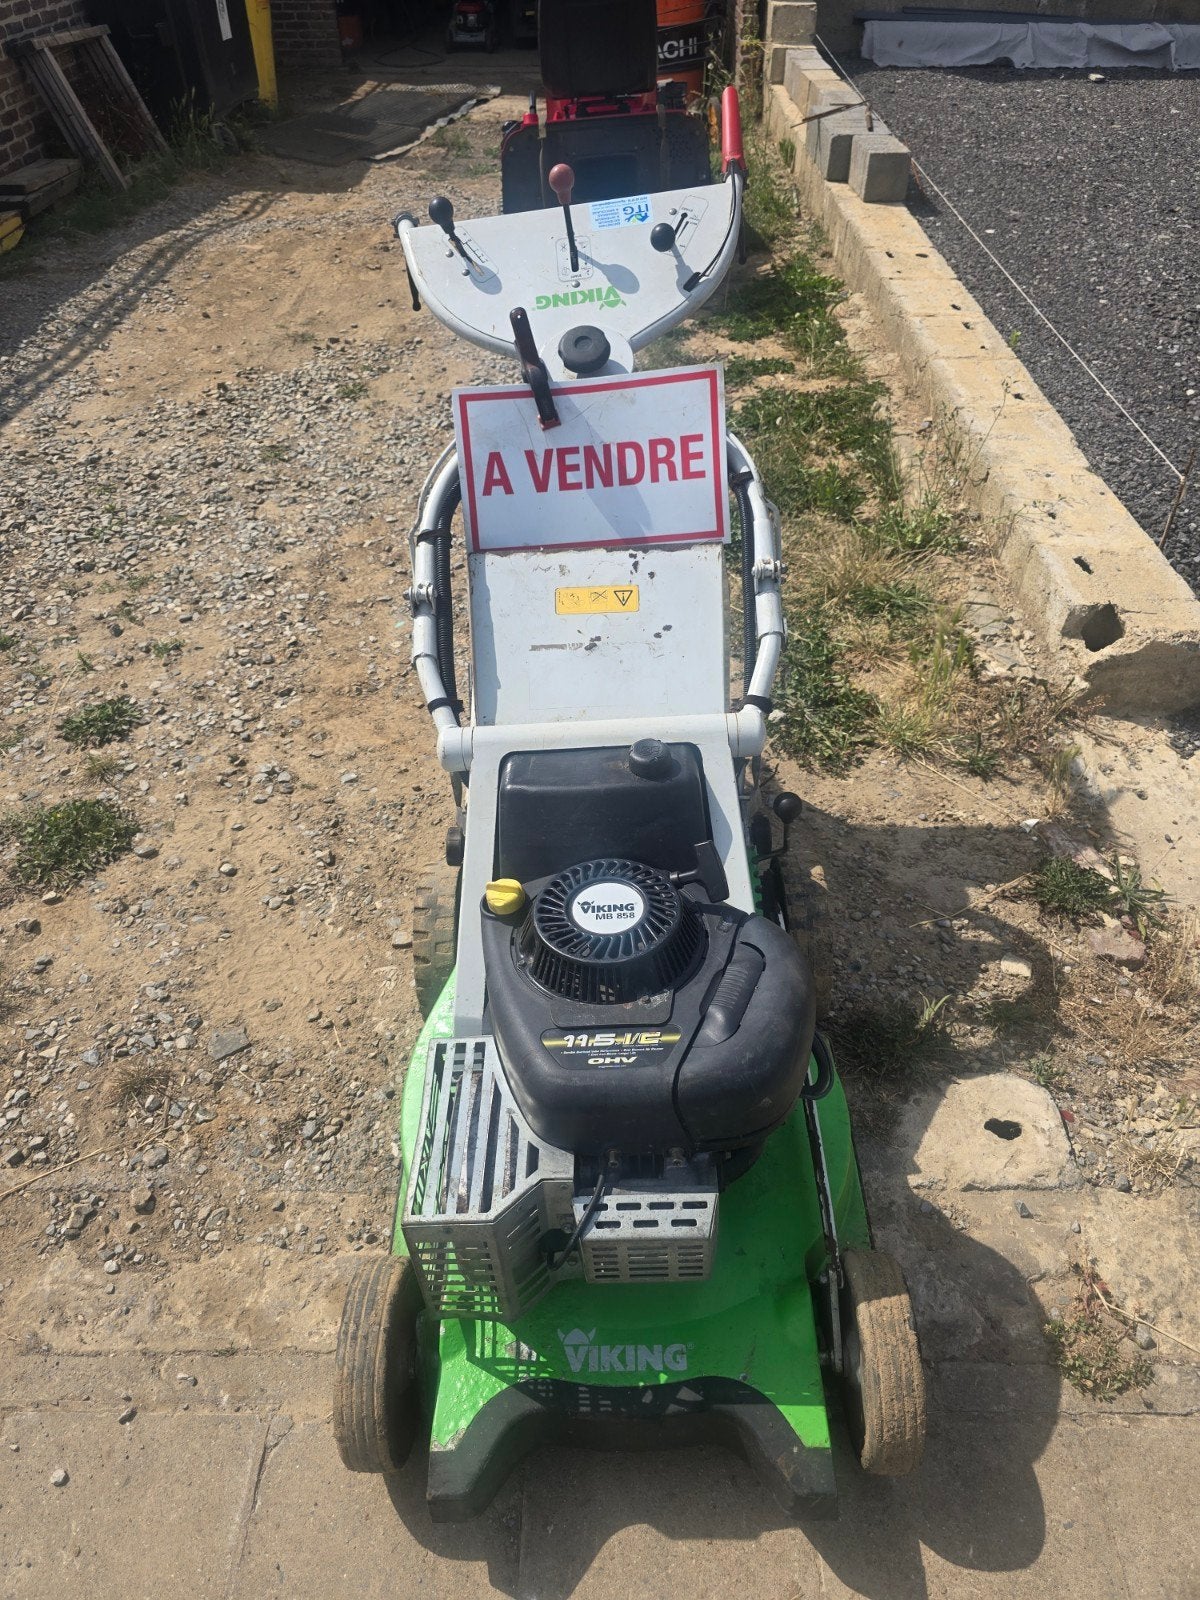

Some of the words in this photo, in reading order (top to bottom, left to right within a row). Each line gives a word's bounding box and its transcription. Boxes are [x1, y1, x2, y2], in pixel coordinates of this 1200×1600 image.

[622, 204, 649, 215] ITG
[536, 286, 621, 310] VIKING
[482, 451, 514, 497] A
[524, 433, 706, 494] VENDRE
[579, 902, 635, 914] VIKING
[563, 1033, 616, 1048] 11.5
[587, 1056, 638, 1065] OHV
[563, 1342, 688, 1373] VIKING
